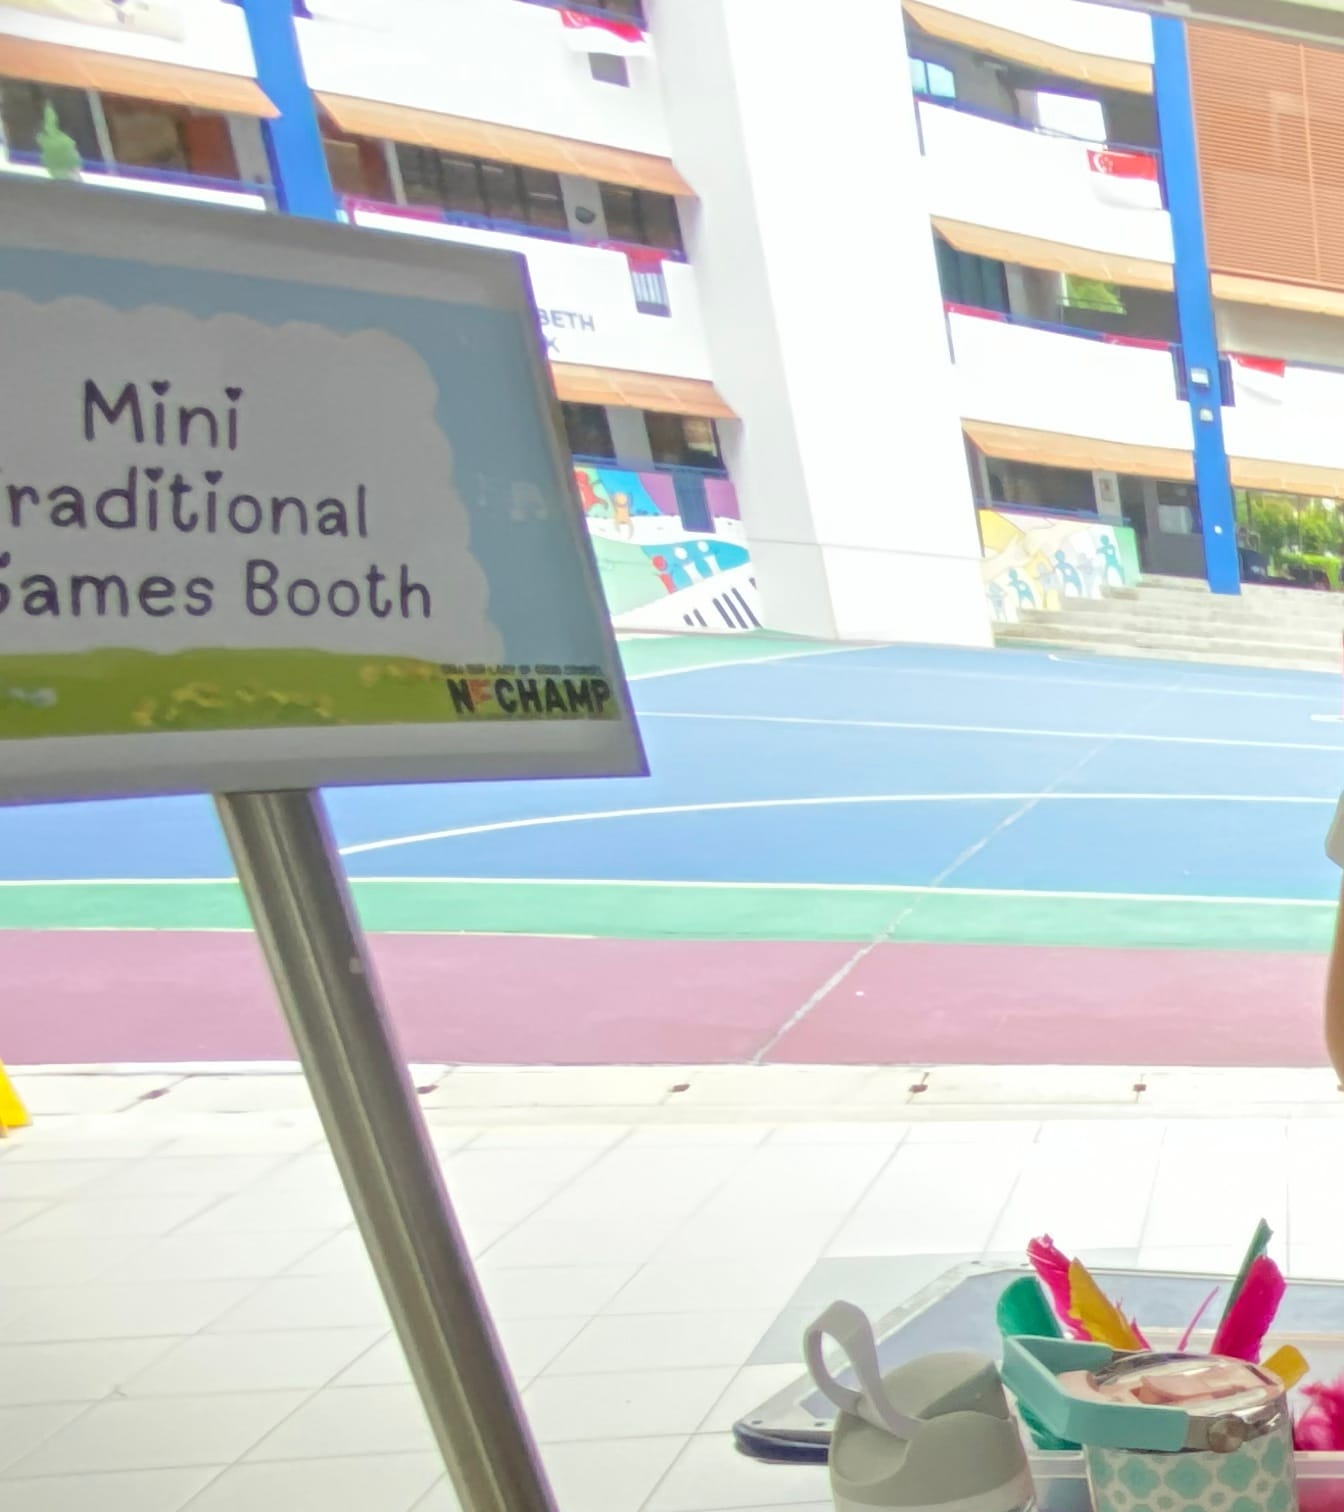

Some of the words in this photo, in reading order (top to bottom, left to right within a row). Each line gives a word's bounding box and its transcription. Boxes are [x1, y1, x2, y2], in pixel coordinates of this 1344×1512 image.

[84, 379, 242, 450] Mini
[0, 466, 368, 538] raditional
[246, 559, 431, 618] Booth
